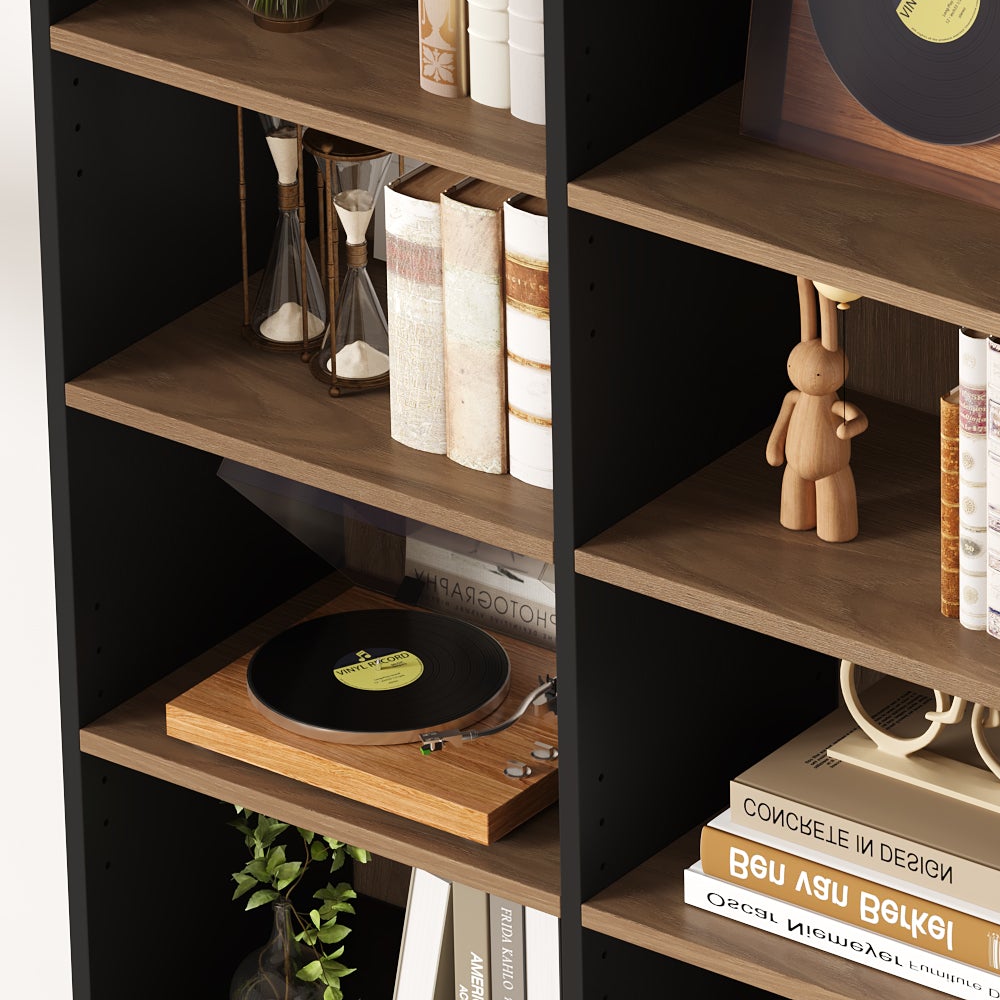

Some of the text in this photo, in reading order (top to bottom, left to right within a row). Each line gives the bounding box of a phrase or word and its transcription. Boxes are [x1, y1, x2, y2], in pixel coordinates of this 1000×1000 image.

[336, 664, 367, 675] VINYL
[368, 652, 410, 667] RCORD
[501, 907, 513, 943] FRIDA
[502, 947, 514, 990] KAHLO
